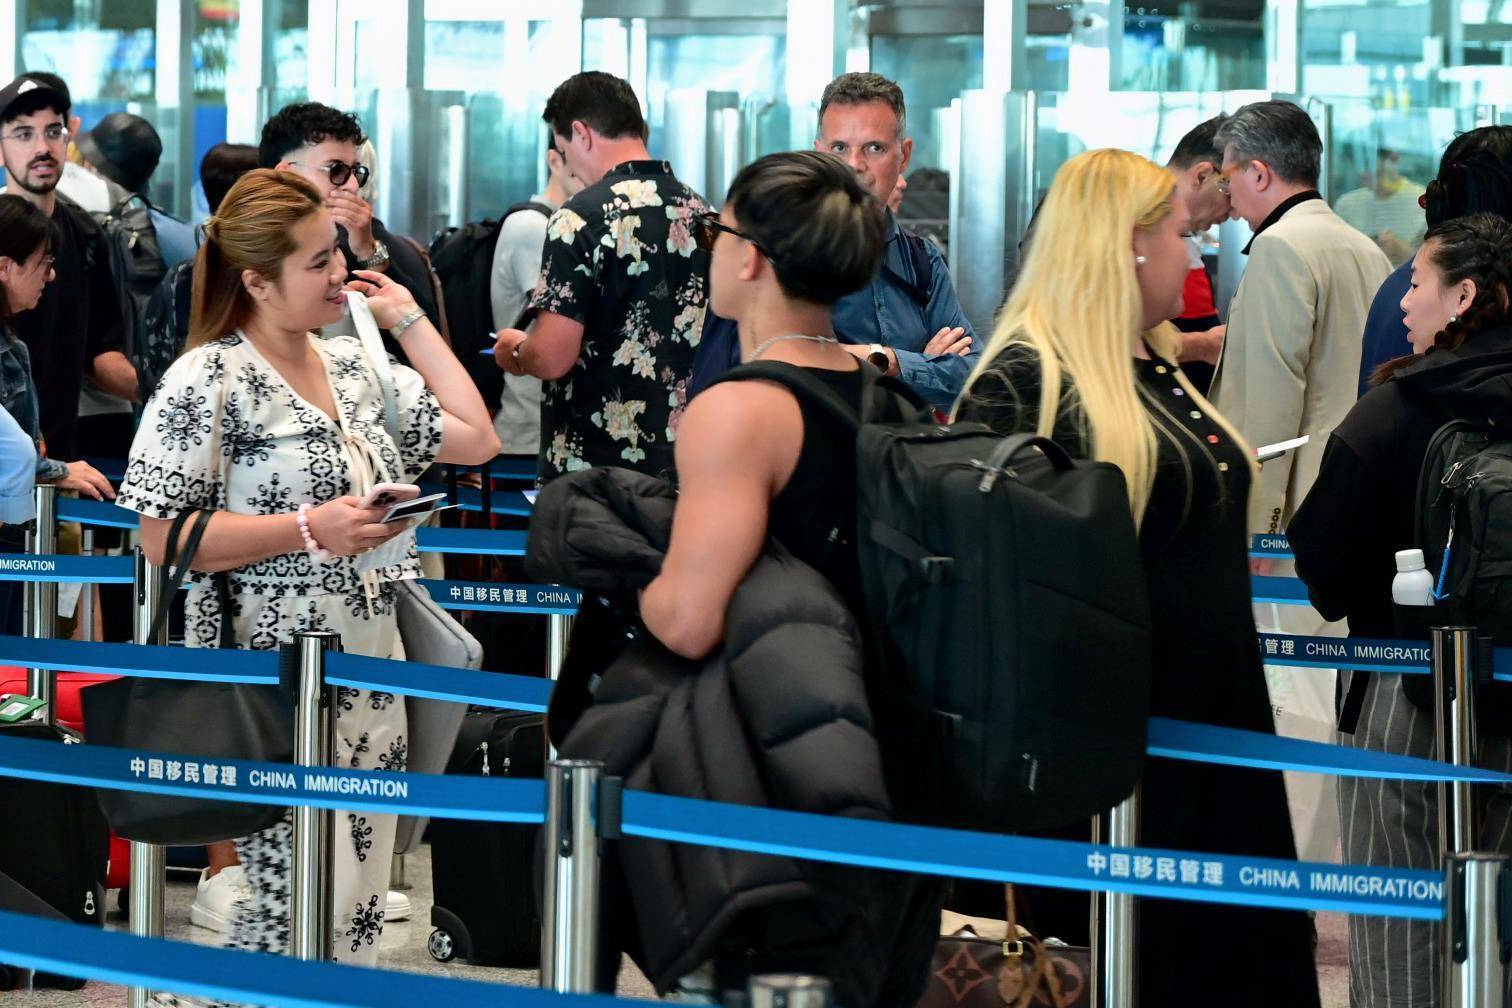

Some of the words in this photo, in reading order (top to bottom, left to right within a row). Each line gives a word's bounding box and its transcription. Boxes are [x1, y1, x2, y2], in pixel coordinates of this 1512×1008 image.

[450, 585, 528, 603] 中国移民管理
[536, 591, 572, 603] CHINA
[1305, 642, 1348, 657] CHINA
[130, 756, 238, 787] 中国移民管理
[248, 769, 297, 790] CHINA
[304, 774, 408, 798] IMMIGRATION
[1087, 851, 1224, 886] 中国移民管理
[1239, 865, 1300, 889] CHINA
[1310, 872, 1443, 900] IMMIGRATION
